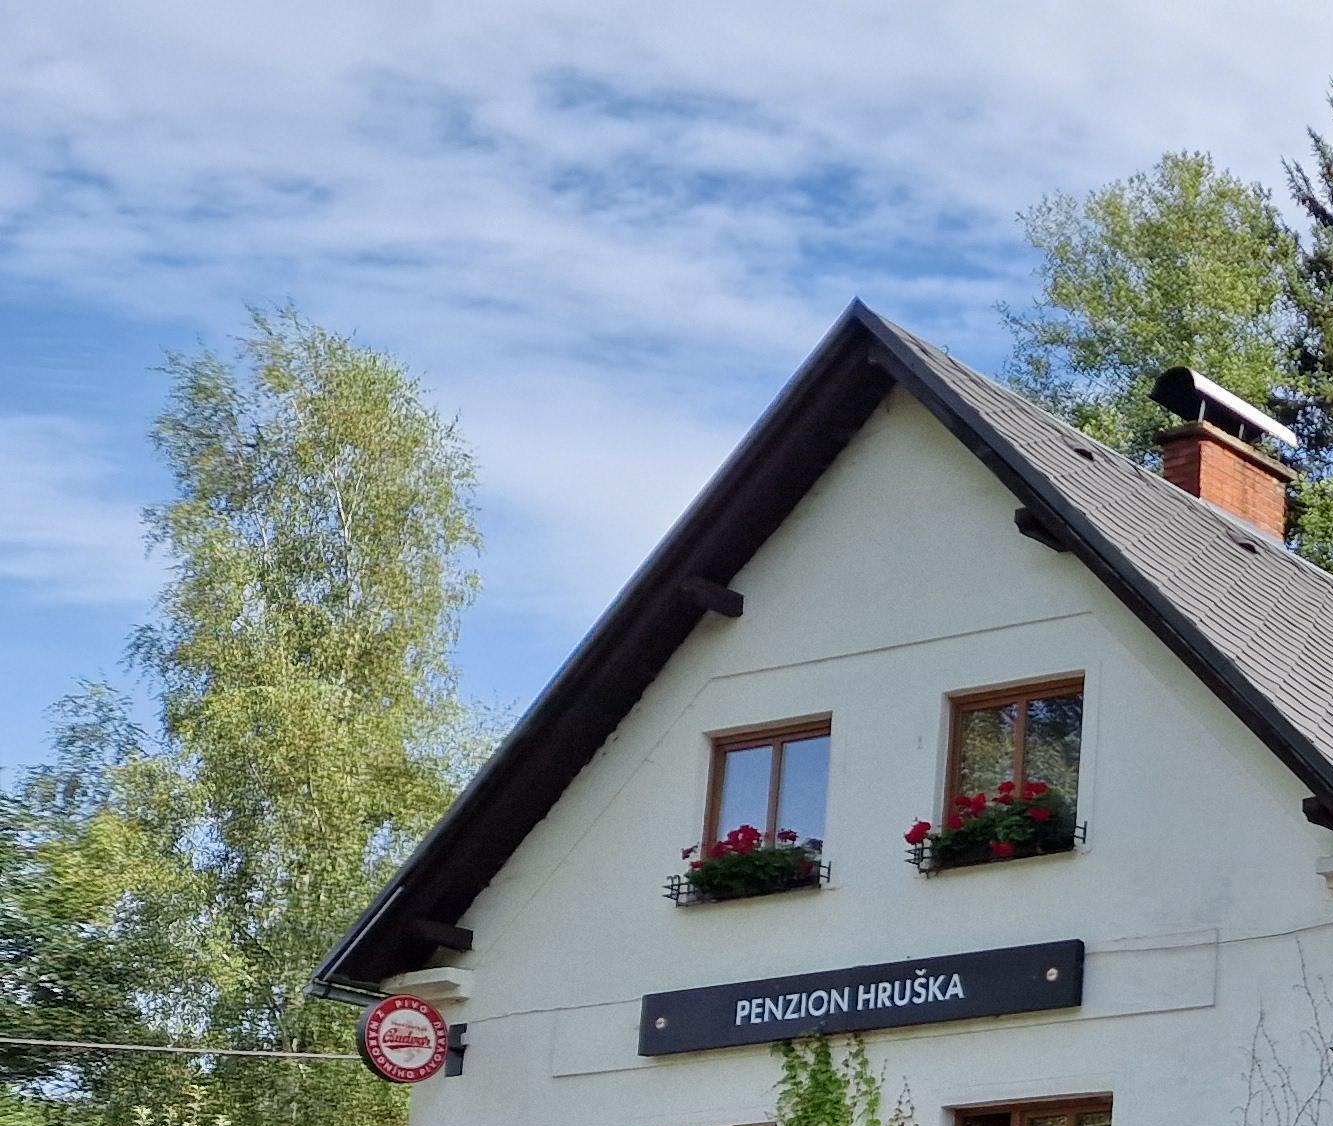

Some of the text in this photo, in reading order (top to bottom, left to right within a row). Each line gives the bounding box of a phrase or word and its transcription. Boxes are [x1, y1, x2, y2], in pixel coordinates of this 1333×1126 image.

[394, 998, 429, 1014] PIVO
[735, 968, 965, 1026] PENZION HRUŠKA
